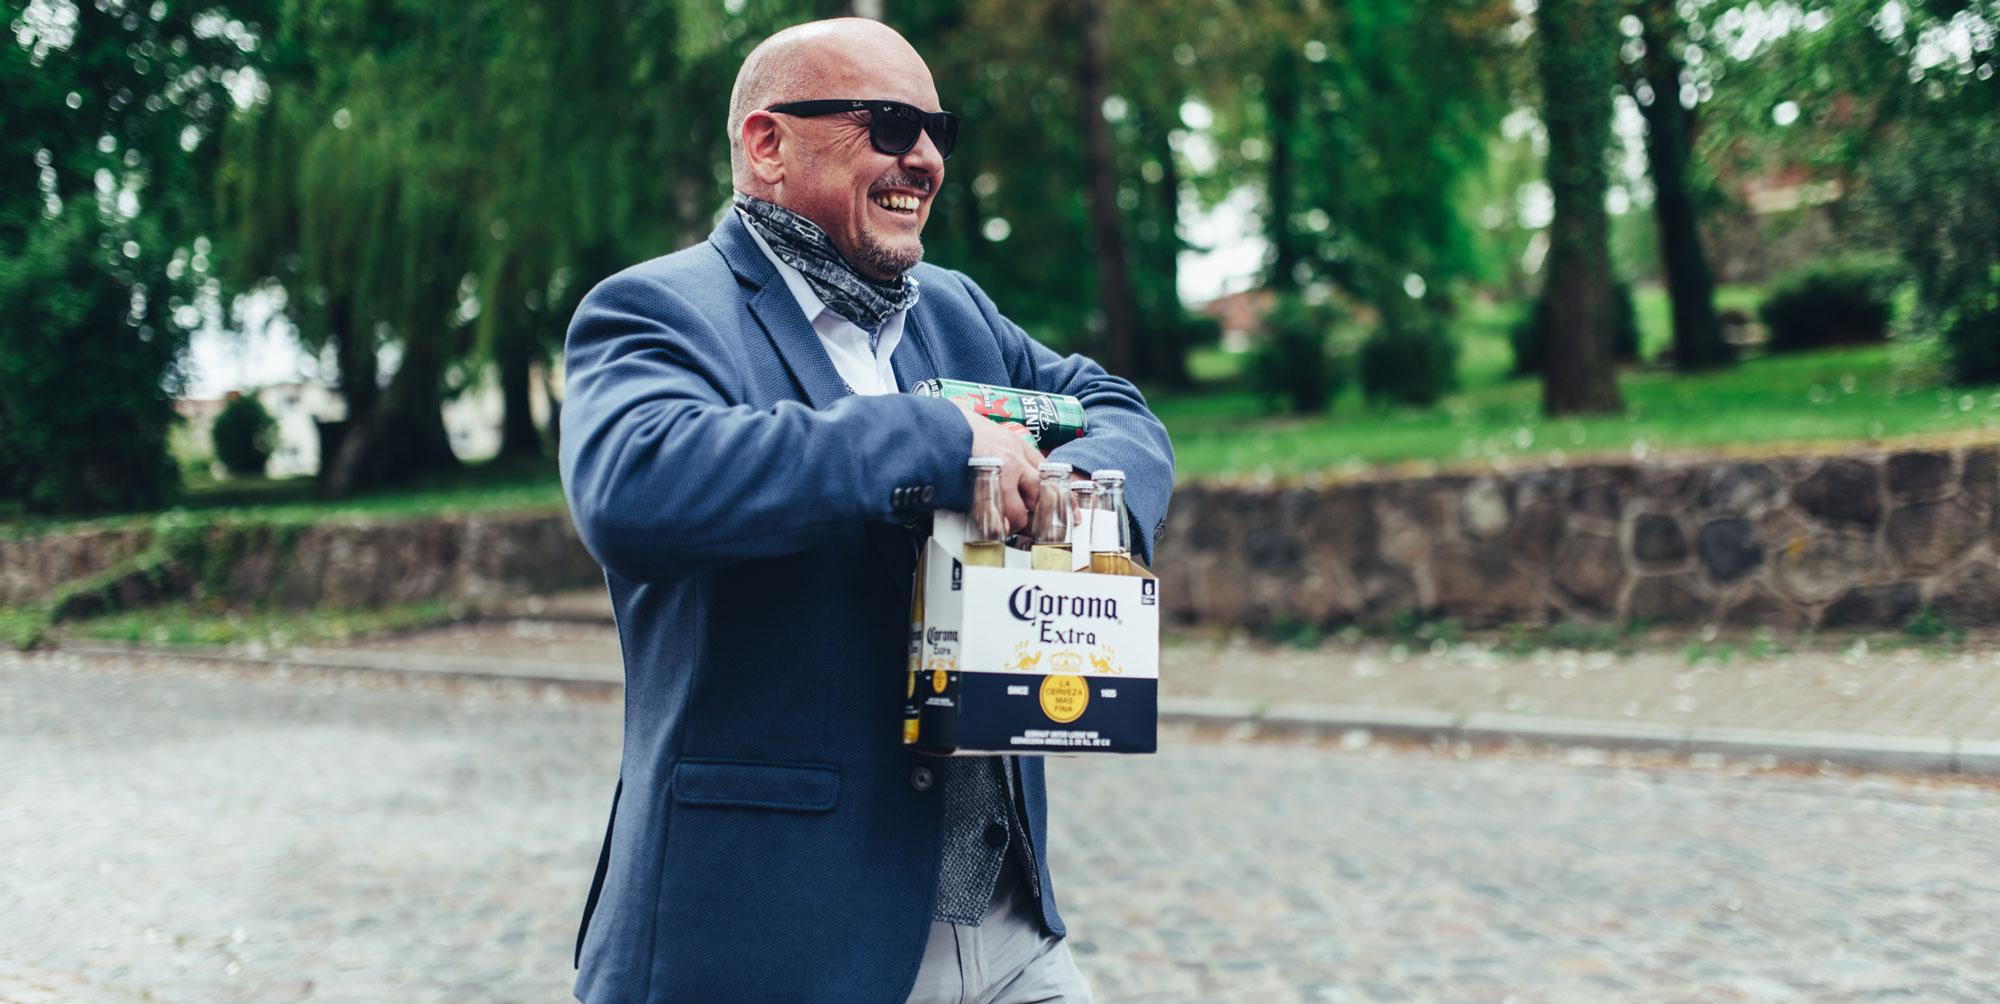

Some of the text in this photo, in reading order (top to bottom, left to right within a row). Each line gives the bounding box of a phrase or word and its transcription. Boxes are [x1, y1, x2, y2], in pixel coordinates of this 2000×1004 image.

[1144, 582, 1153, 595] 6
[1008, 584, 1118, 626] Corona
[926, 626, 958, 645] Corona
[1040, 619, 1096, 645] Extra
[1059, 680, 1071, 688] LA
[1046, 687, 1083, 697] CERVEZA
[1054, 705, 1073, 713] FINA
